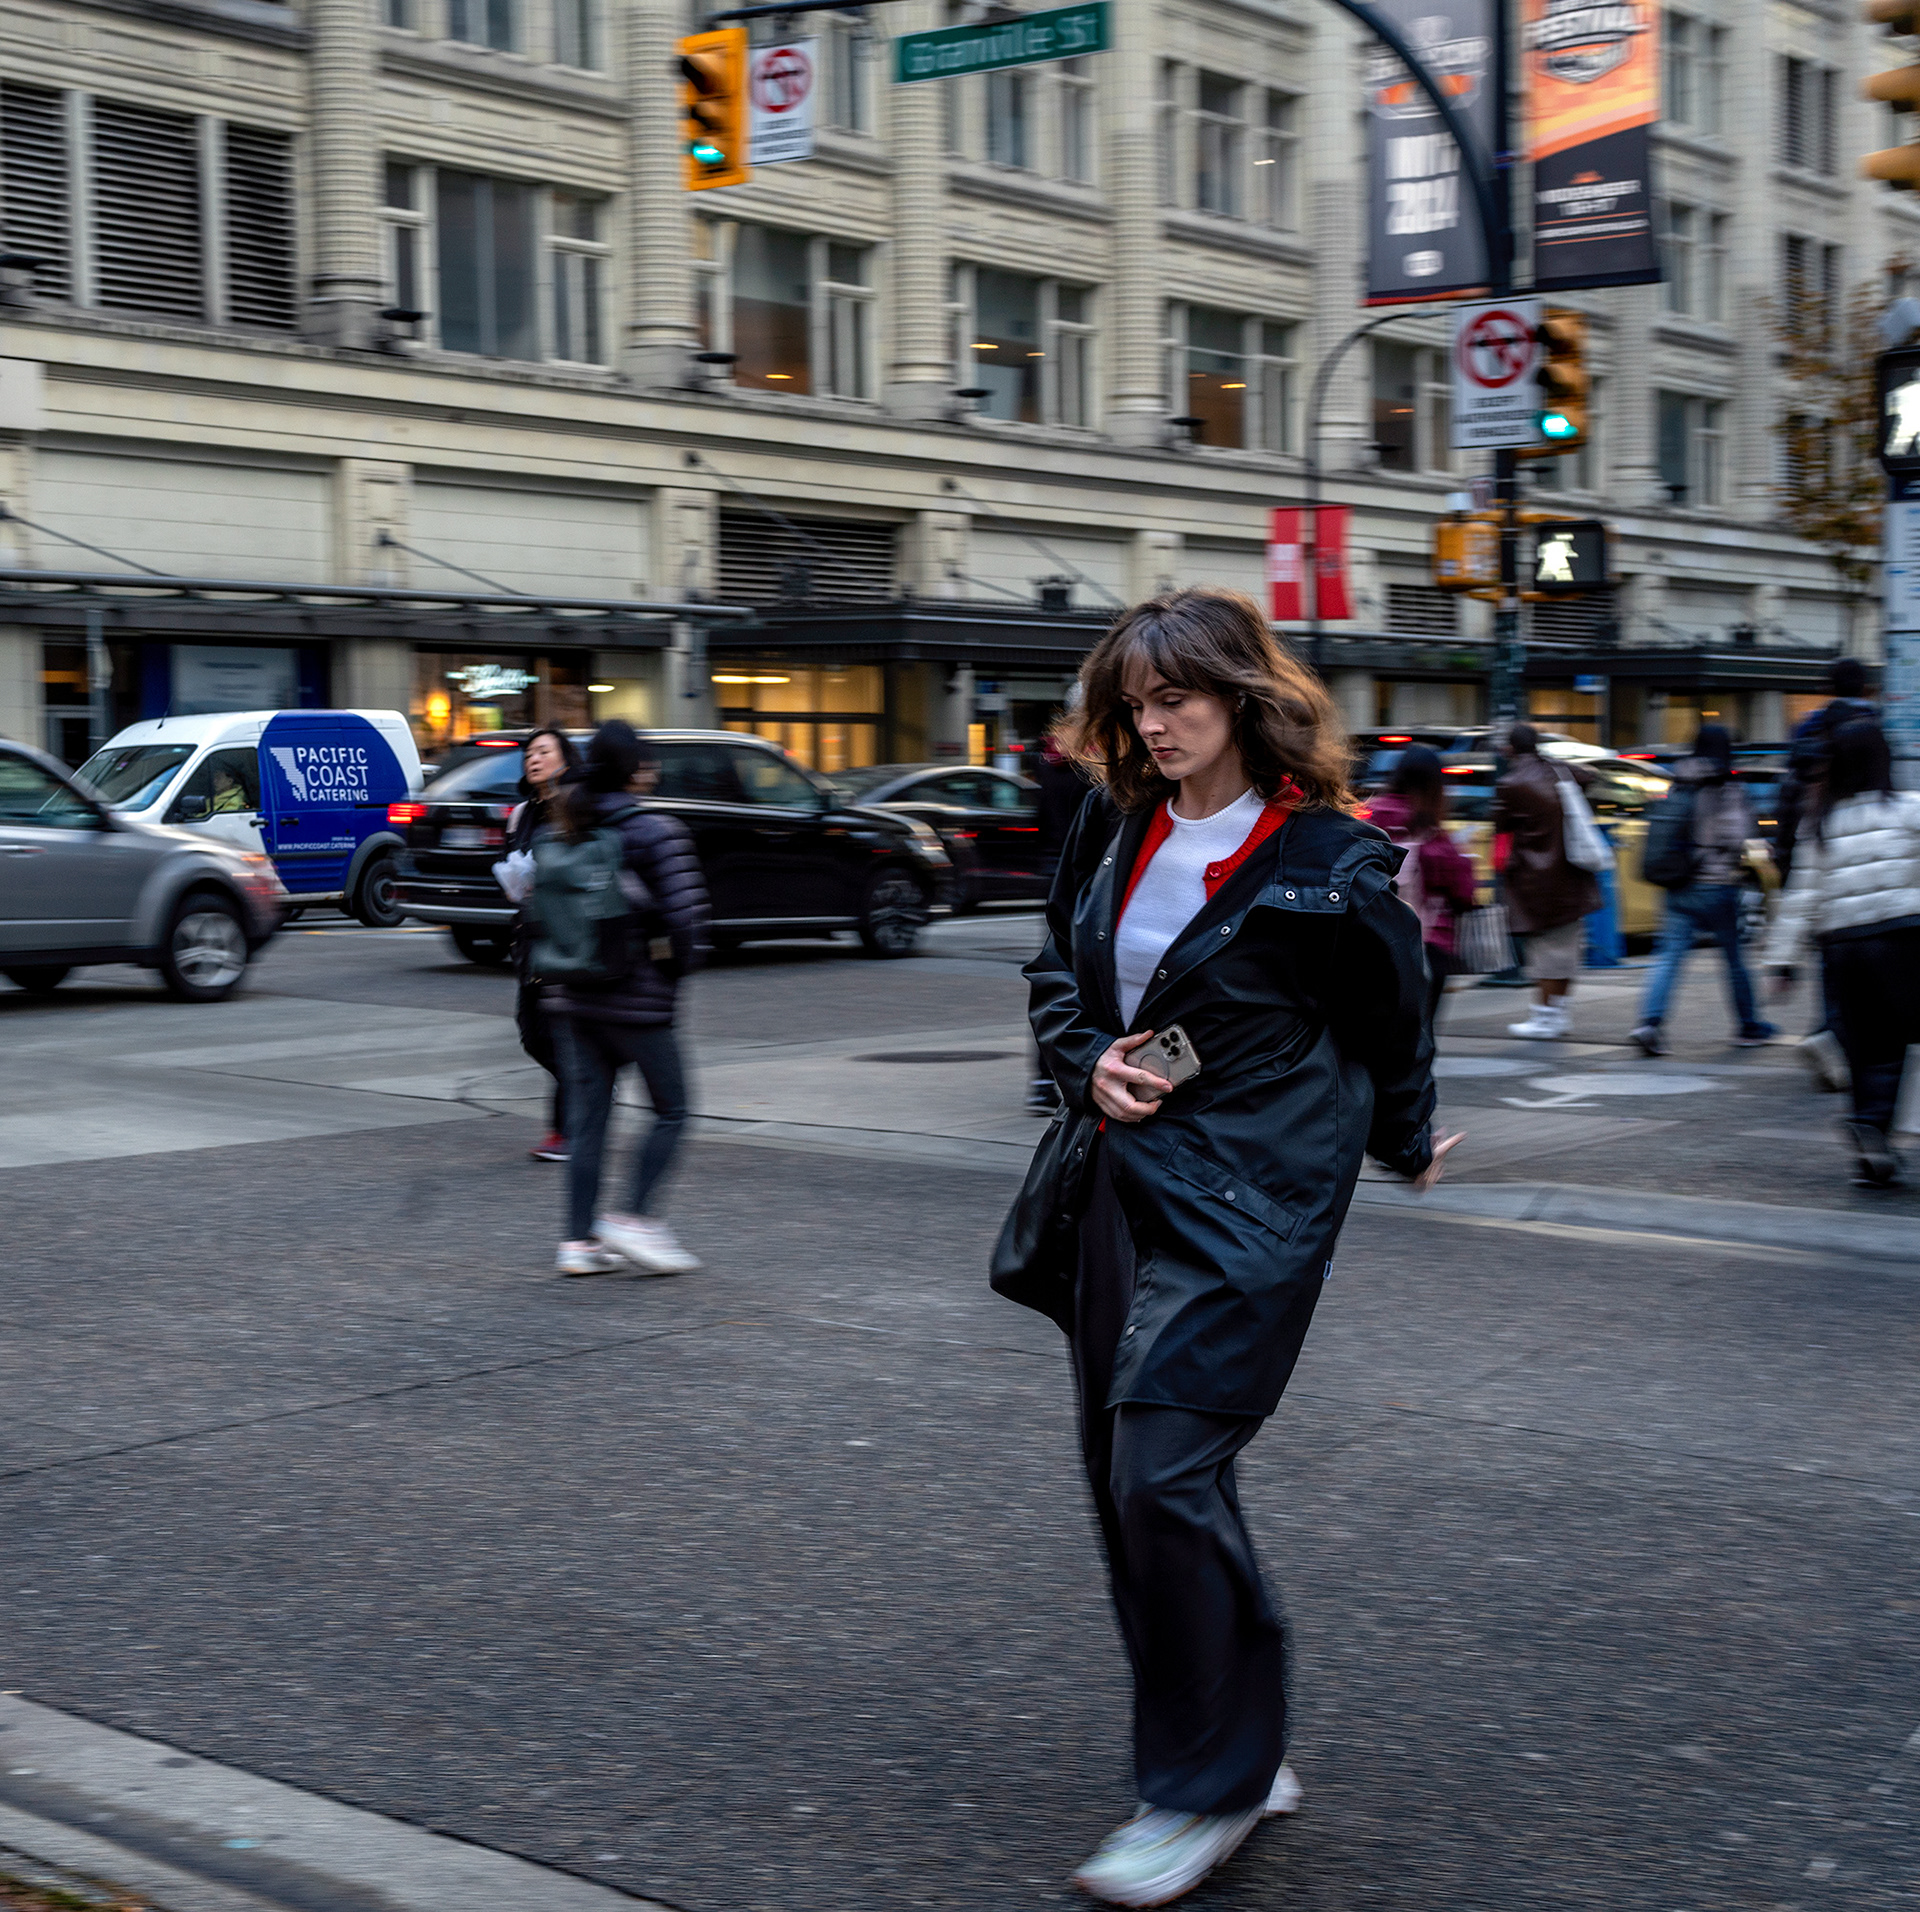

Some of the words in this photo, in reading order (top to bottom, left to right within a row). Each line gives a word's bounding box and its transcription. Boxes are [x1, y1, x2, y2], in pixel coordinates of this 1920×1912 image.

[903, 22, 1056, 74] Granville
[1056, 12, 1099, 49] St
[296, 747, 367, 764] PACIFIC
[306, 765, 369, 787] COAST
[309, 788, 369, 802] CATERING
